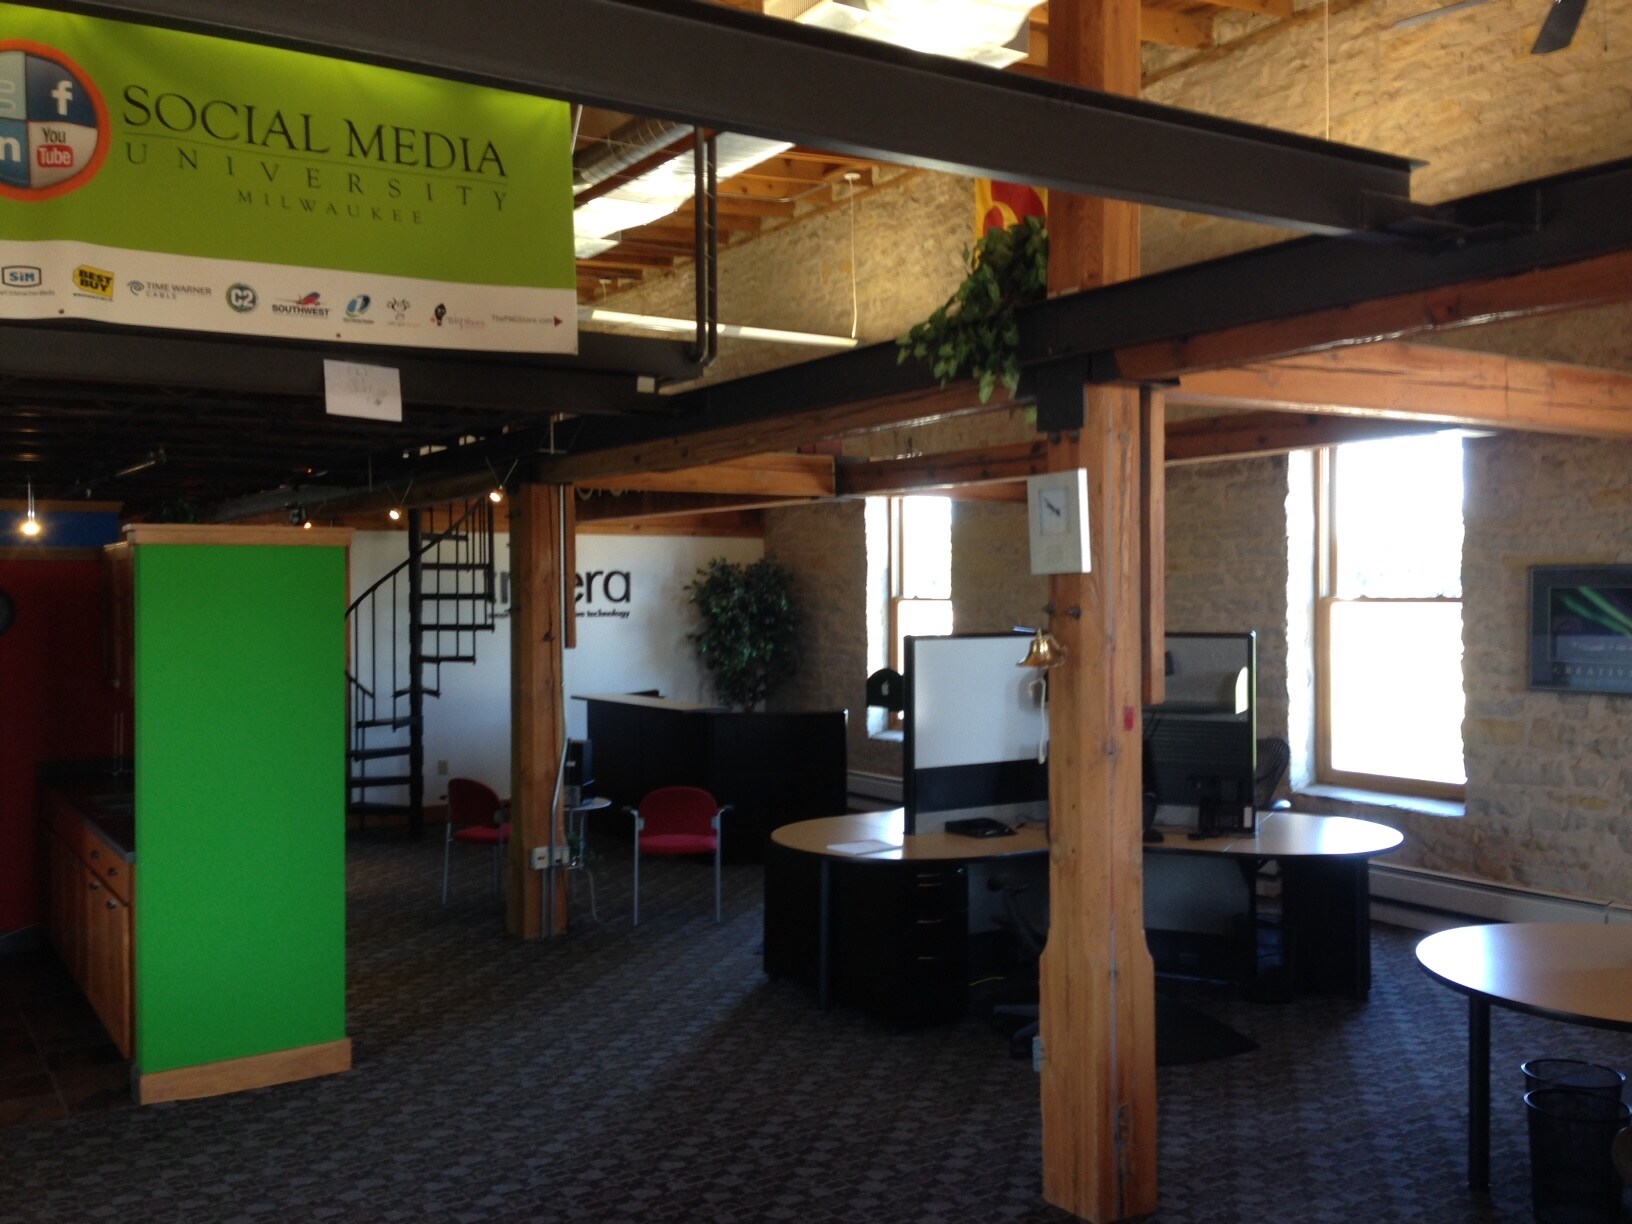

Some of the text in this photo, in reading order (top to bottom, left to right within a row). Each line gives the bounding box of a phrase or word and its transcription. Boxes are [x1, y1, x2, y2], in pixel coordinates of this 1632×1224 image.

[42, 127, 67, 143] You
[122, 84, 508, 178] SOCIAL MEDIA
[37, 147, 72, 165] Tube
[125, 142, 507, 212] UNIVERSITY
[237, 189, 424, 225] MILWAUKEE
[79, 269, 113, 285] BEST
[80, 279, 108, 292] BUY
[145, 281, 212, 296] TIME WARNER
[230, 288, 256, 308] C2
[271, 303, 331, 317] SOUTHWEST
